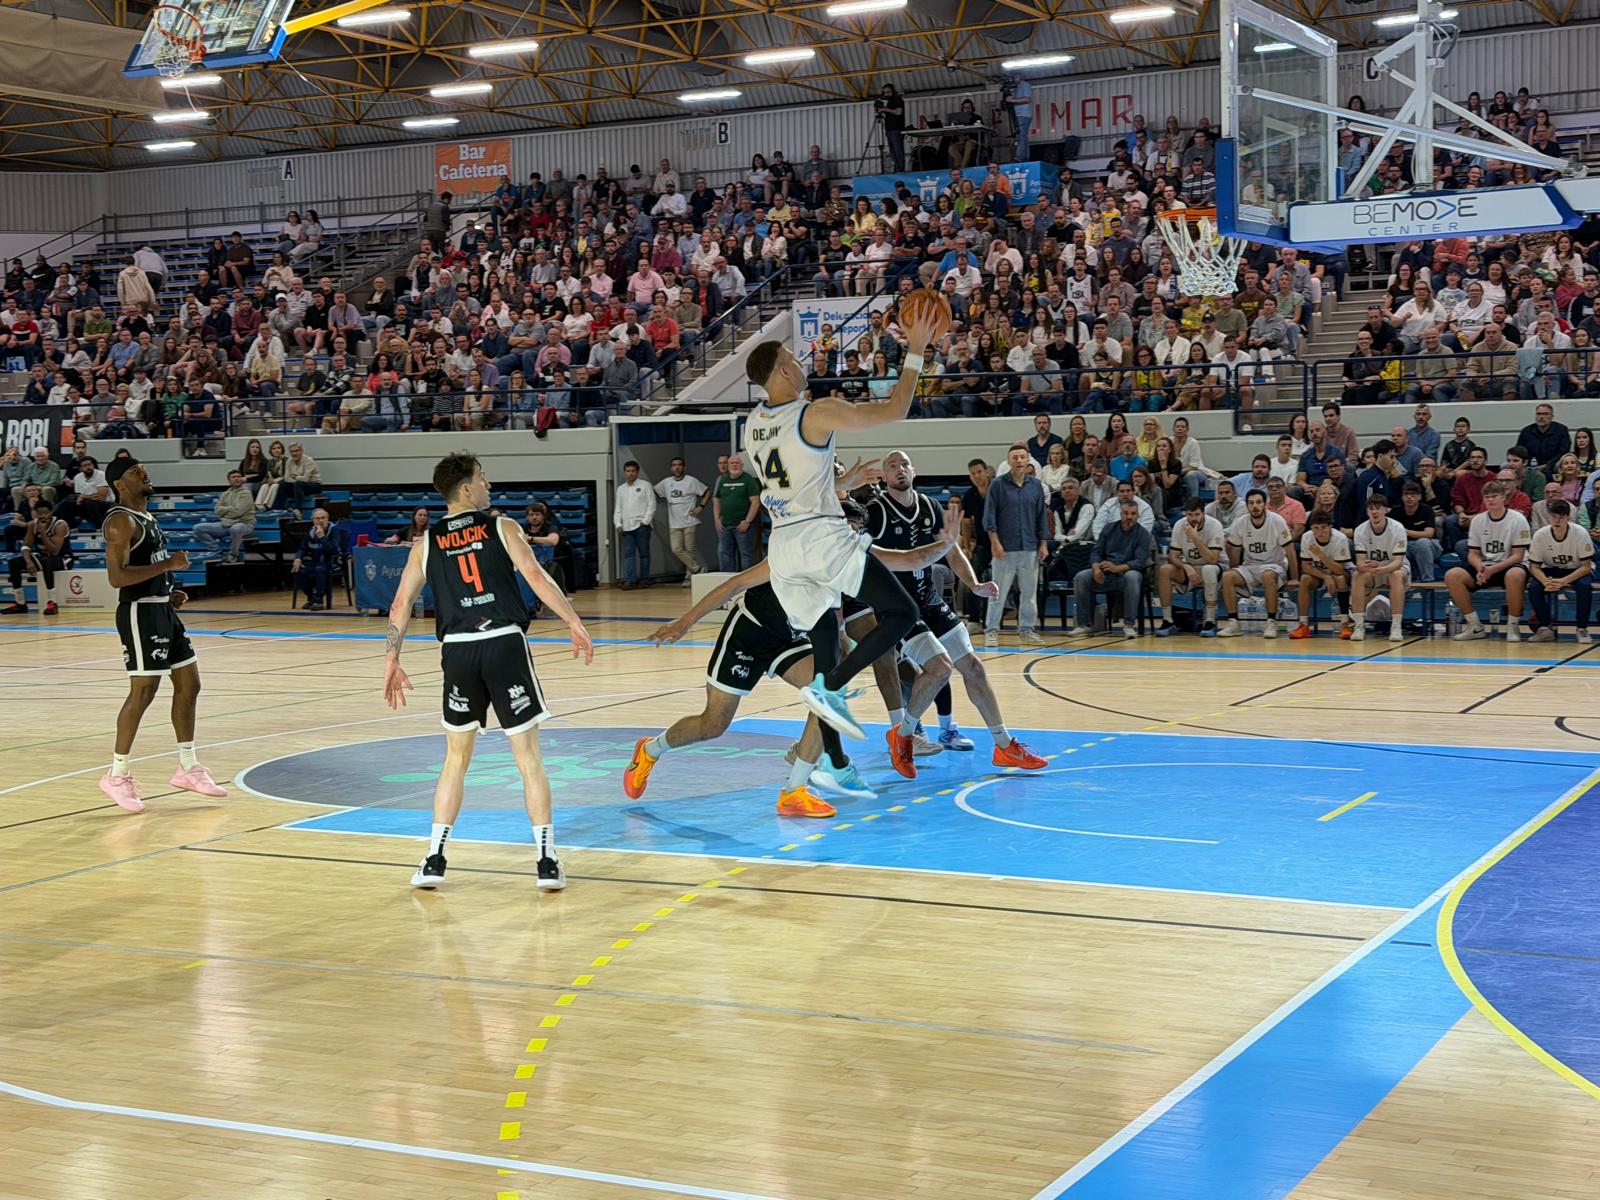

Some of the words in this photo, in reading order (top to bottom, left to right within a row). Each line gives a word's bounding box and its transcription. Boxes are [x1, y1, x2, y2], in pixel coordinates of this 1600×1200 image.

[1366, 57, 1379, 79] C
[718, 121, 729, 144] B
[458, 144, 487, 161] Bar
[283, 159, 294, 180] A
[438, 160, 508, 181] Cafetería
[1367, 221, 1459, 237] CENTER
[436, 524, 488, 550] WOJCIK
[1485, 539, 1506, 554] CBA
[1370, 549, 1390, 562] CBA
[457, 551, 484, 593] 4
